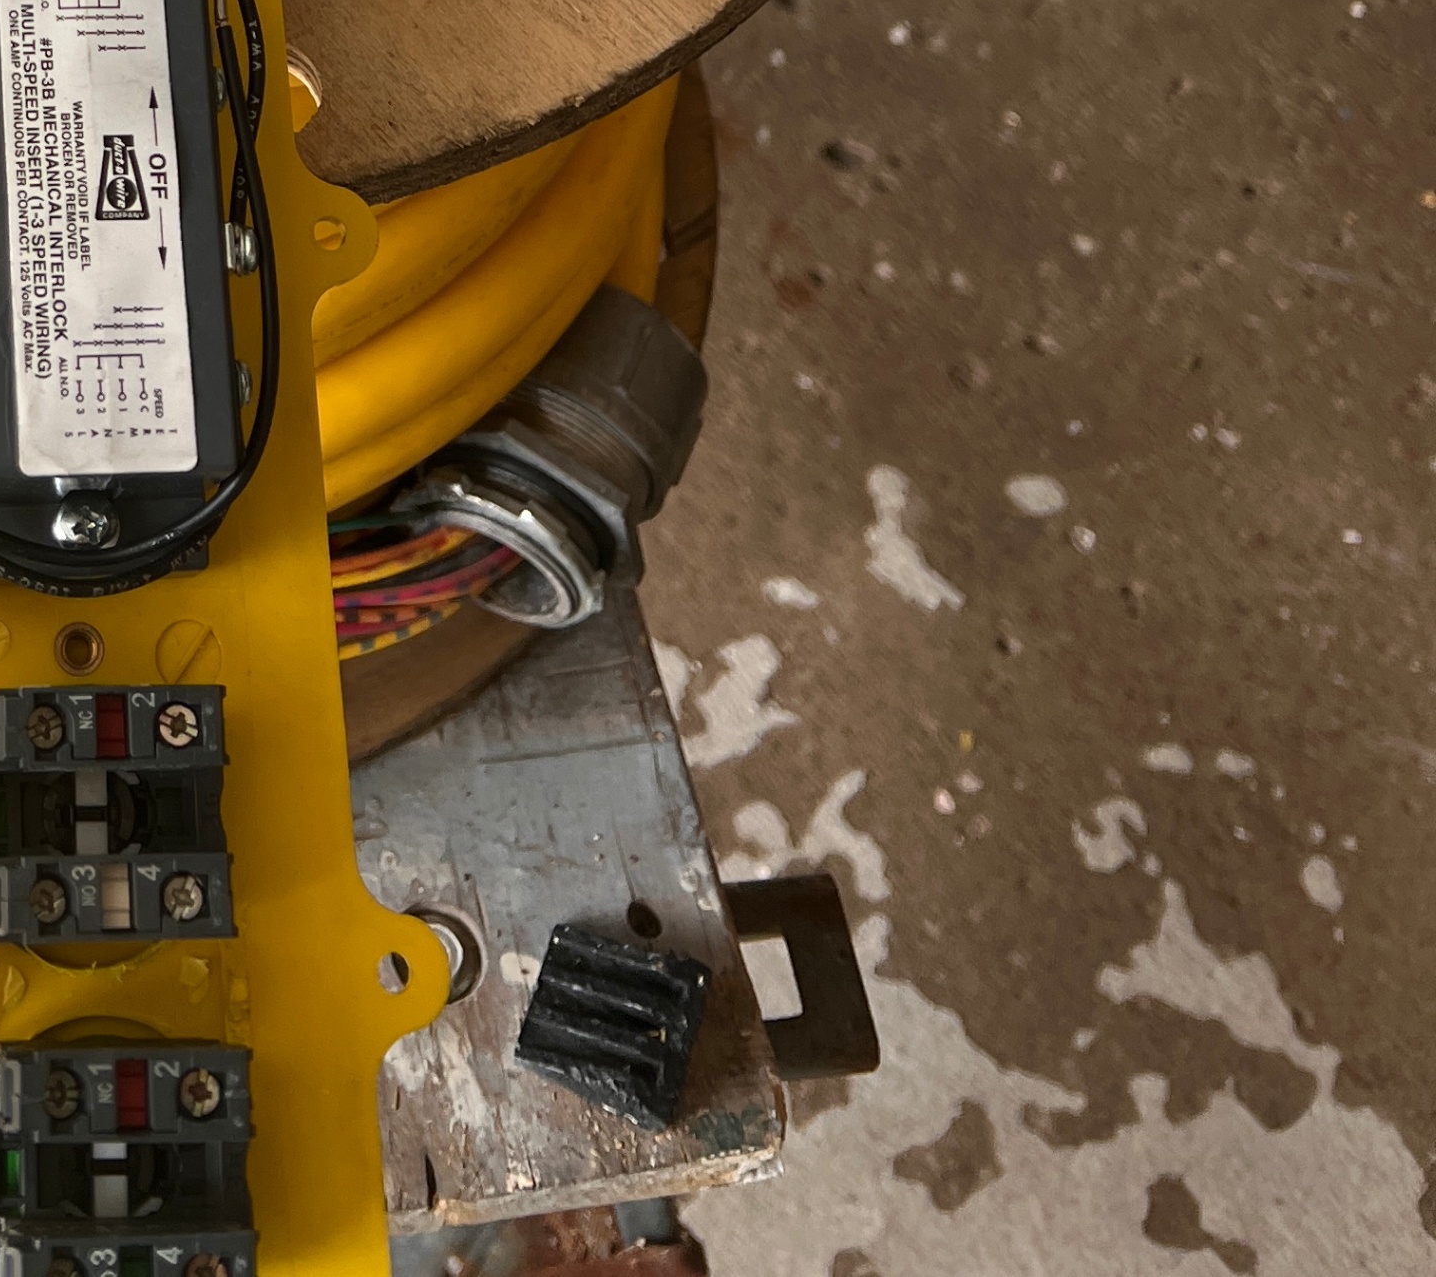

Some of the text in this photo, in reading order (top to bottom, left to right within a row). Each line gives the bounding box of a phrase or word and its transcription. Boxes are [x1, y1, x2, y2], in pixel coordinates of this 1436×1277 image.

[8, 10, 34, 373] ONE AMP CONTINUOUS PER CONTACT. 125 Volts AC Max.
[20, 4, 51, 379] MULTI-SPEED INSERT (1-3 SPEED WIRING)
[39, 37, 67, 341] #PB-3B MECHANICAL INTERLOCK
[60, 112, 78, 259] BROKEN OR REMOVED
[72, 101, 91, 271] WARRANTY VOID IF LABEL
[148, 153, 168, 199] OFF
[69, 695, 94, 730] NC 1
[132, 692, 156, 707] 2
[72, 865, 96, 907] NO 3
[137, 865, 162, 881] 4
[88, 1062, 114, 1104] NC 1
[153, 1060, 181, 1078] 2
[90, 1248, 117, 1266] 3
[156, 1247, 184, 1264] 4
